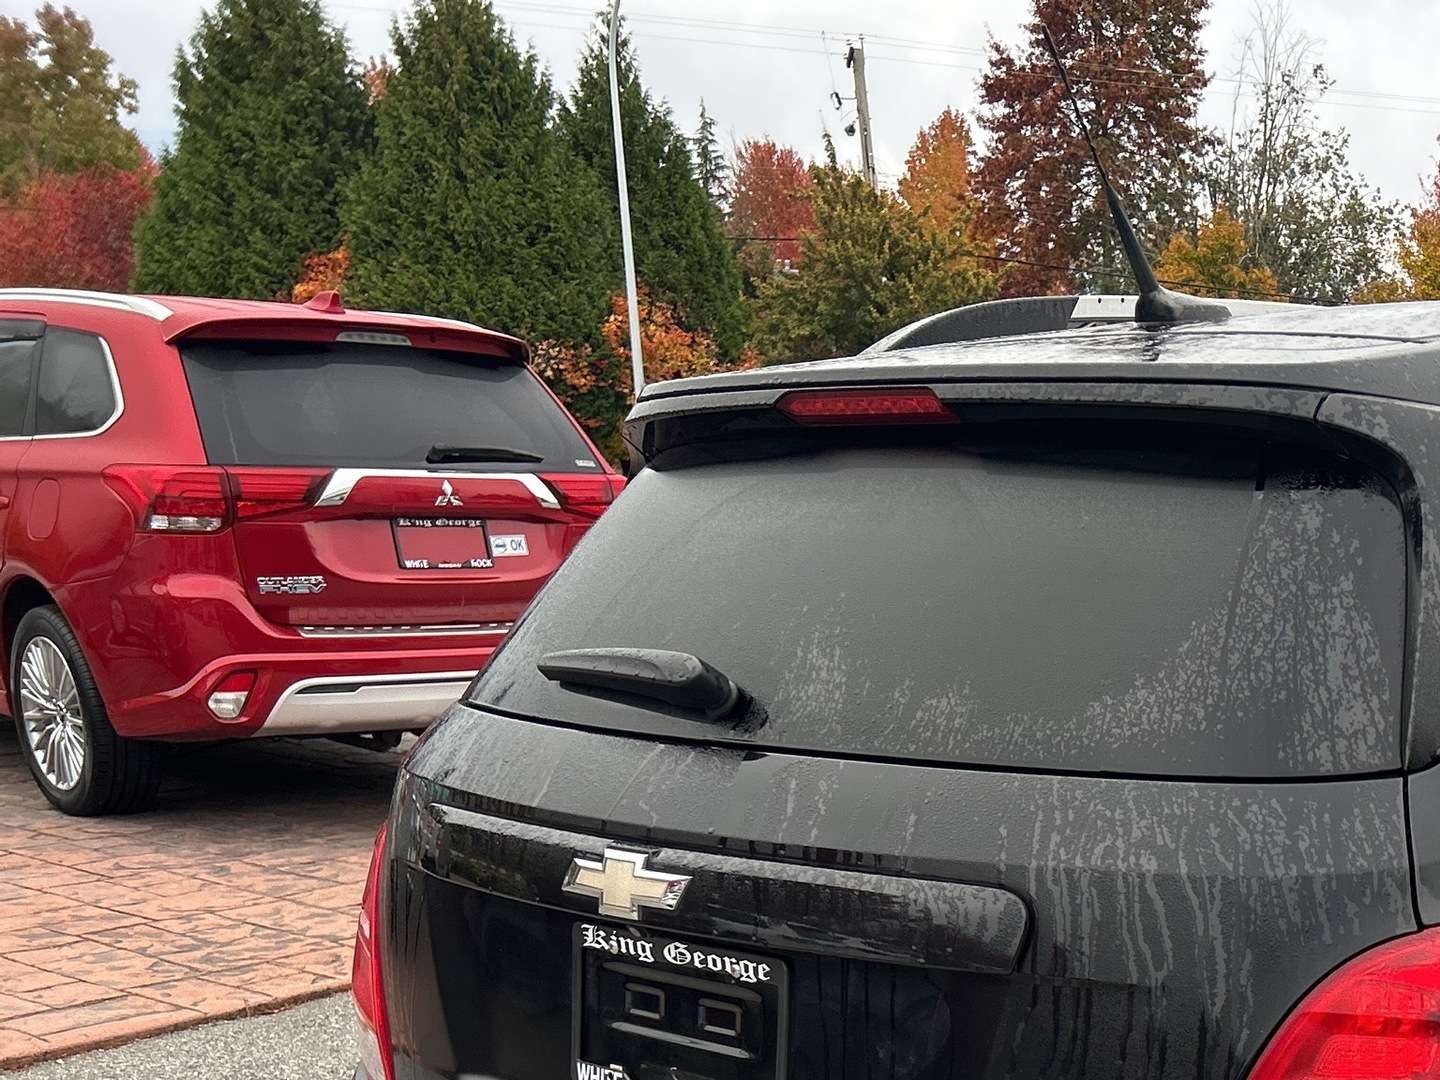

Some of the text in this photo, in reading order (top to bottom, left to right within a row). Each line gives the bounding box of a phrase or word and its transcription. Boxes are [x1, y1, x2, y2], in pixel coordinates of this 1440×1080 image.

[510, 539, 525, 551] OK
[580, 923, 771, 983] King George
